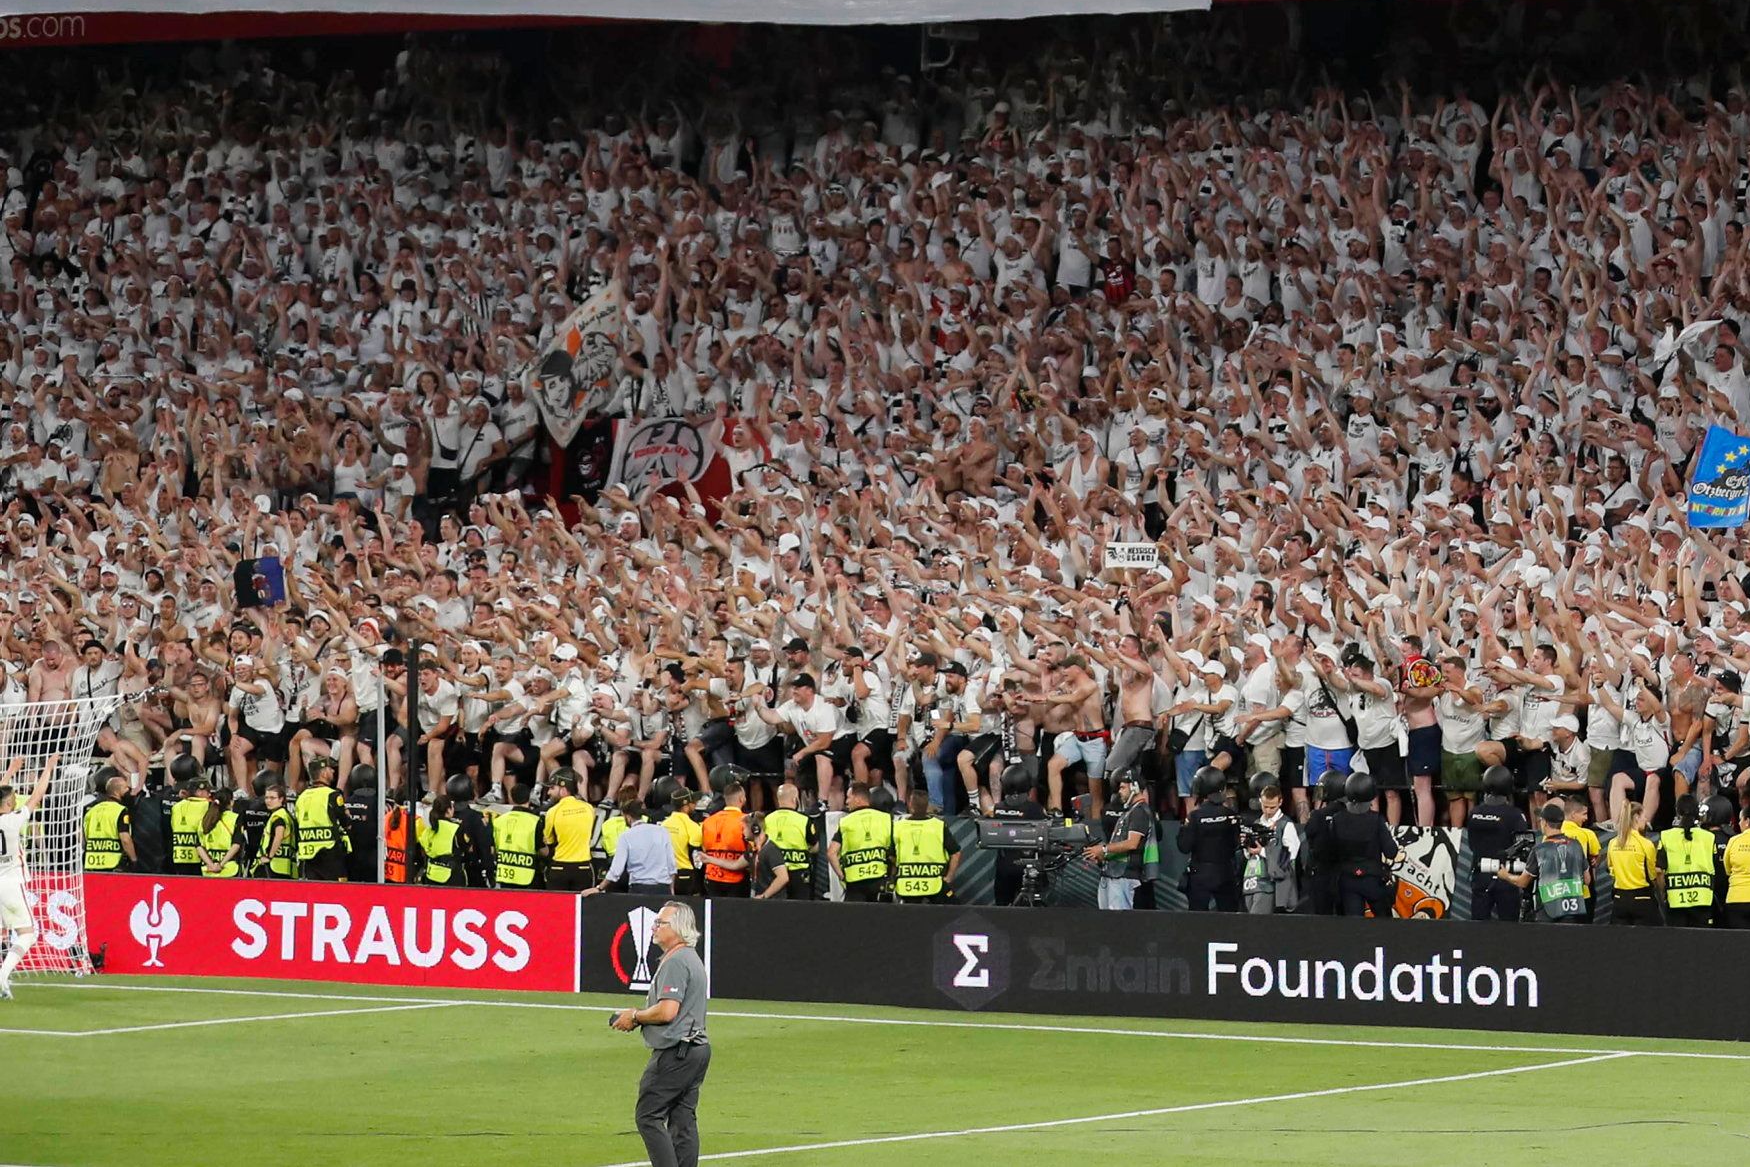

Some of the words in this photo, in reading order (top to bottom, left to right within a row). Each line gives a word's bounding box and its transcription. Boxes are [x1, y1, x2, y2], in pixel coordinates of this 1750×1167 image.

[858, 864, 879, 877] 542
[905, 880, 930, 892] 543
[1679, 891, 1699, 904] 132
[1562, 898, 1580, 911] 03
[231, 898, 531, 973] STRAUSS
[1207, 941, 1539, 1009] Foundation
